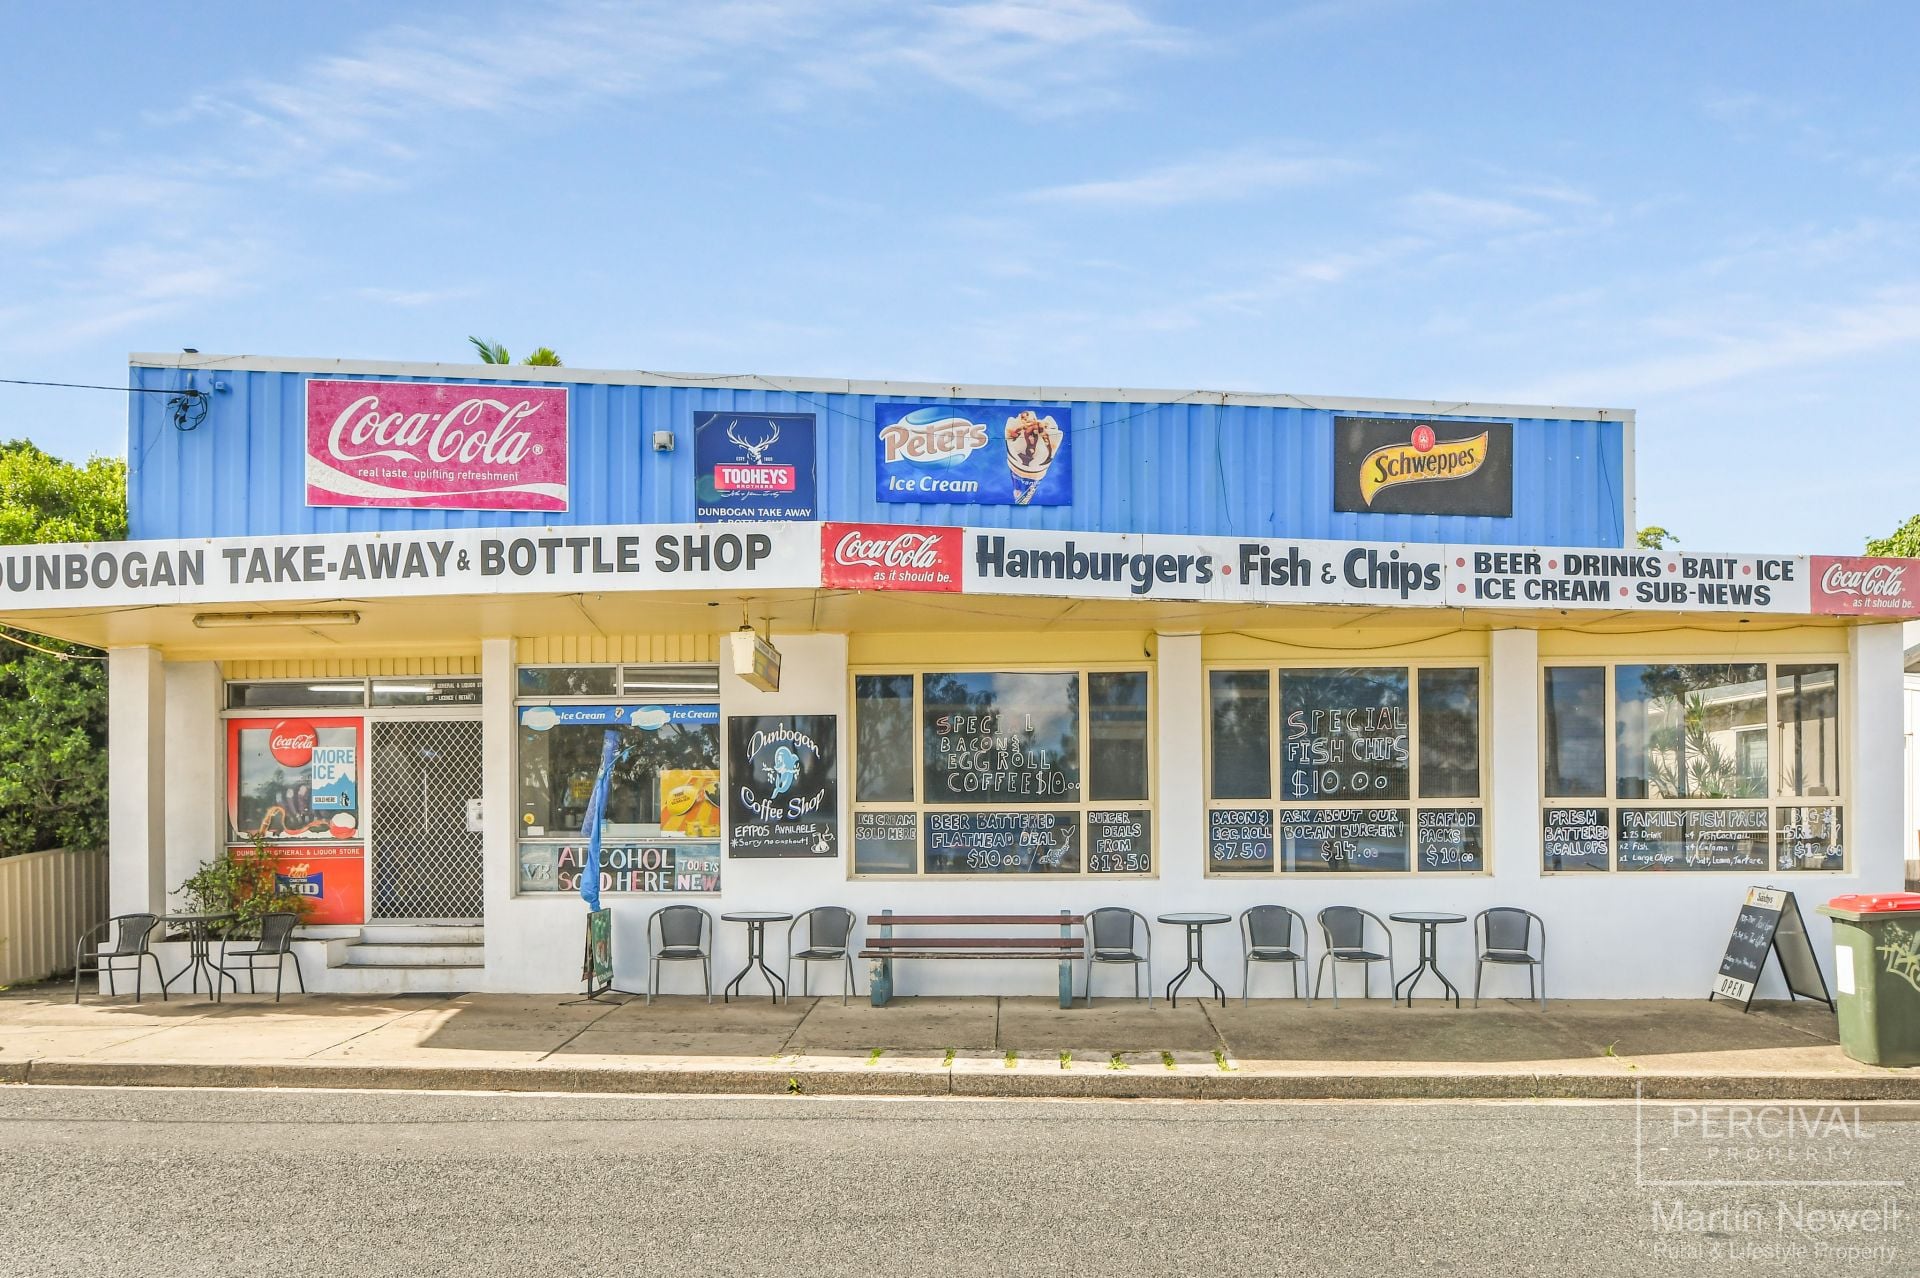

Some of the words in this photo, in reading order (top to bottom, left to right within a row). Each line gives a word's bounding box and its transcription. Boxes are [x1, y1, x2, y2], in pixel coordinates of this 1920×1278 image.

[328, 396, 544, 464] Coca-Cola
[880, 421, 987, 462] Peters
[1374, 448, 1475, 483] Schweppes
[358, 468, 379, 477] real
[414, 470, 454, 481] uplifting
[457, 471, 518, 481] refreshment
[722, 468, 788, 484] TOOHEYS
[889, 475, 915, 491] Ice
[919, 476, 979, 493] Cream
[698, 508, 755, 516] DUNBOGAN
[758, 508, 782, 516] TAKE
[785, 508, 812, 517] AWAY
[834, 531, 943, 568] Coca-Cola
[0, 550, 205, 593] UNBOGAN
[222, 541, 454, 584] TAKE-AWAY
[456, 549, 471, 571] &
[481, 536, 640, 576] BOTTLE
[655, 533, 772, 572] SHOP
[976, 535, 1214, 594] Hamburgers
[1474, 551, 1542, 575] BEER
[1564, 554, 1661, 578] DRINKS
[1682, 557, 1738, 580] BAIT
[1756, 559, 1794, 582] ICE
[873, 571, 886, 581] as
[888, 570, 897, 581] it
[899, 570, 935, 583] should
[937, 572, 953, 583] be.
[1239, 543, 1312, 588] Fish
[1321, 562, 1336, 584] &
[1343, 547, 1441, 600] Chips
[1821, 563, 1906, 597] Coca-Cola
[1474, 578, 1515, 600] ICE
[1524, 579, 1610, 602] CREAM
[1636, 581, 1771, 605] SUB-NEWS
[1864, 598, 1872, 607] it
[1873, 599, 1900, 608] should
[561, 712, 574, 720] Ice
[576, 712, 606, 720] Cream
[673, 710, 687, 719] Ice
[688, 711, 718, 719] Cream
[1288, 707, 1408, 739] SPECIAL
[272, 735, 314, 750] Coca-Cola
[747, 723, 821, 763] Dunbogan
[940, 737, 1008, 752] BACON
[1288, 737, 1345, 765] FISH
[1351, 735, 1409, 763] CHIPS
[313, 750, 354, 764] MORE
[947, 751, 990, 772] EGG
[997, 750, 1050, 770] ROLL
[313, 765, 336, 780] ICE
[1291, 769, 1388, 798] $10.00
[741, 786, 783, 821] Coffee
[788, 789, 825, 819] Shop
[858, 814, 874, 825] ICE
[875, 814, 916, 826] CREAM
[931, 814, 968, 830] BEER
[977, 813, 1055, 829] BATTERED
[1089, 811, 1131, 824] BURGER
[1212, 810, 1257, 826] BACON
[1281, 810, 1311, 823] ASK
[1313, 810, 1363, 823] ABOUT
[1369, 808, 1398, 822] OUR
[1419, 812, 1476, 827] SEAFOOD
[1549, 809, 1597, 826] FRESH
[1623, 811, 1688, 827] FAMILY
[1689, 810, 1726, 828] FISH
[1729, 810, 1768, 828] PACK
[735, 825, 770, 837] EFTPOS
[775, 824, 817, 834] AVAILABLE
[856, 827, 886, 840] SOLD
[888, 828, 917, 840] HERE
[1102, 823, 1142, 838] DEALS
[1212, 827, 1241, 841] EGG
[1241, 826, 1272, 840] ROLL
[1284, 824, 1336, 840] BOGAN
[1420, 828, 1461, 844] PACKS
[1544, 825, 1609, 842] BATTERED
[931, 832, 1015, 849] FLATHEAD
[1019, 831, 1057, 847] DEAL
[1096, 838, 1132, 853] FROM
[1620, 842, 1629, 850] x2
[1632, 842, 1649, 850] Fish
[1214, 842, 1267, 860] $7.50
[1426, 844, 1474, 867] $10.00
[1545, 841, 1608, 856] SCALLOPS
[679, 859, 720, 873] TOOHEYS
[1632, 854, 1654, 864] Large
[1654, 853, 1675, 864] Chips
[558, 872, 613, 891] SOD
[616, 871, 673, 892] HERE
[677, 874, 718, 892] NEW
[1721, 978, 1745, 998] OPEN
